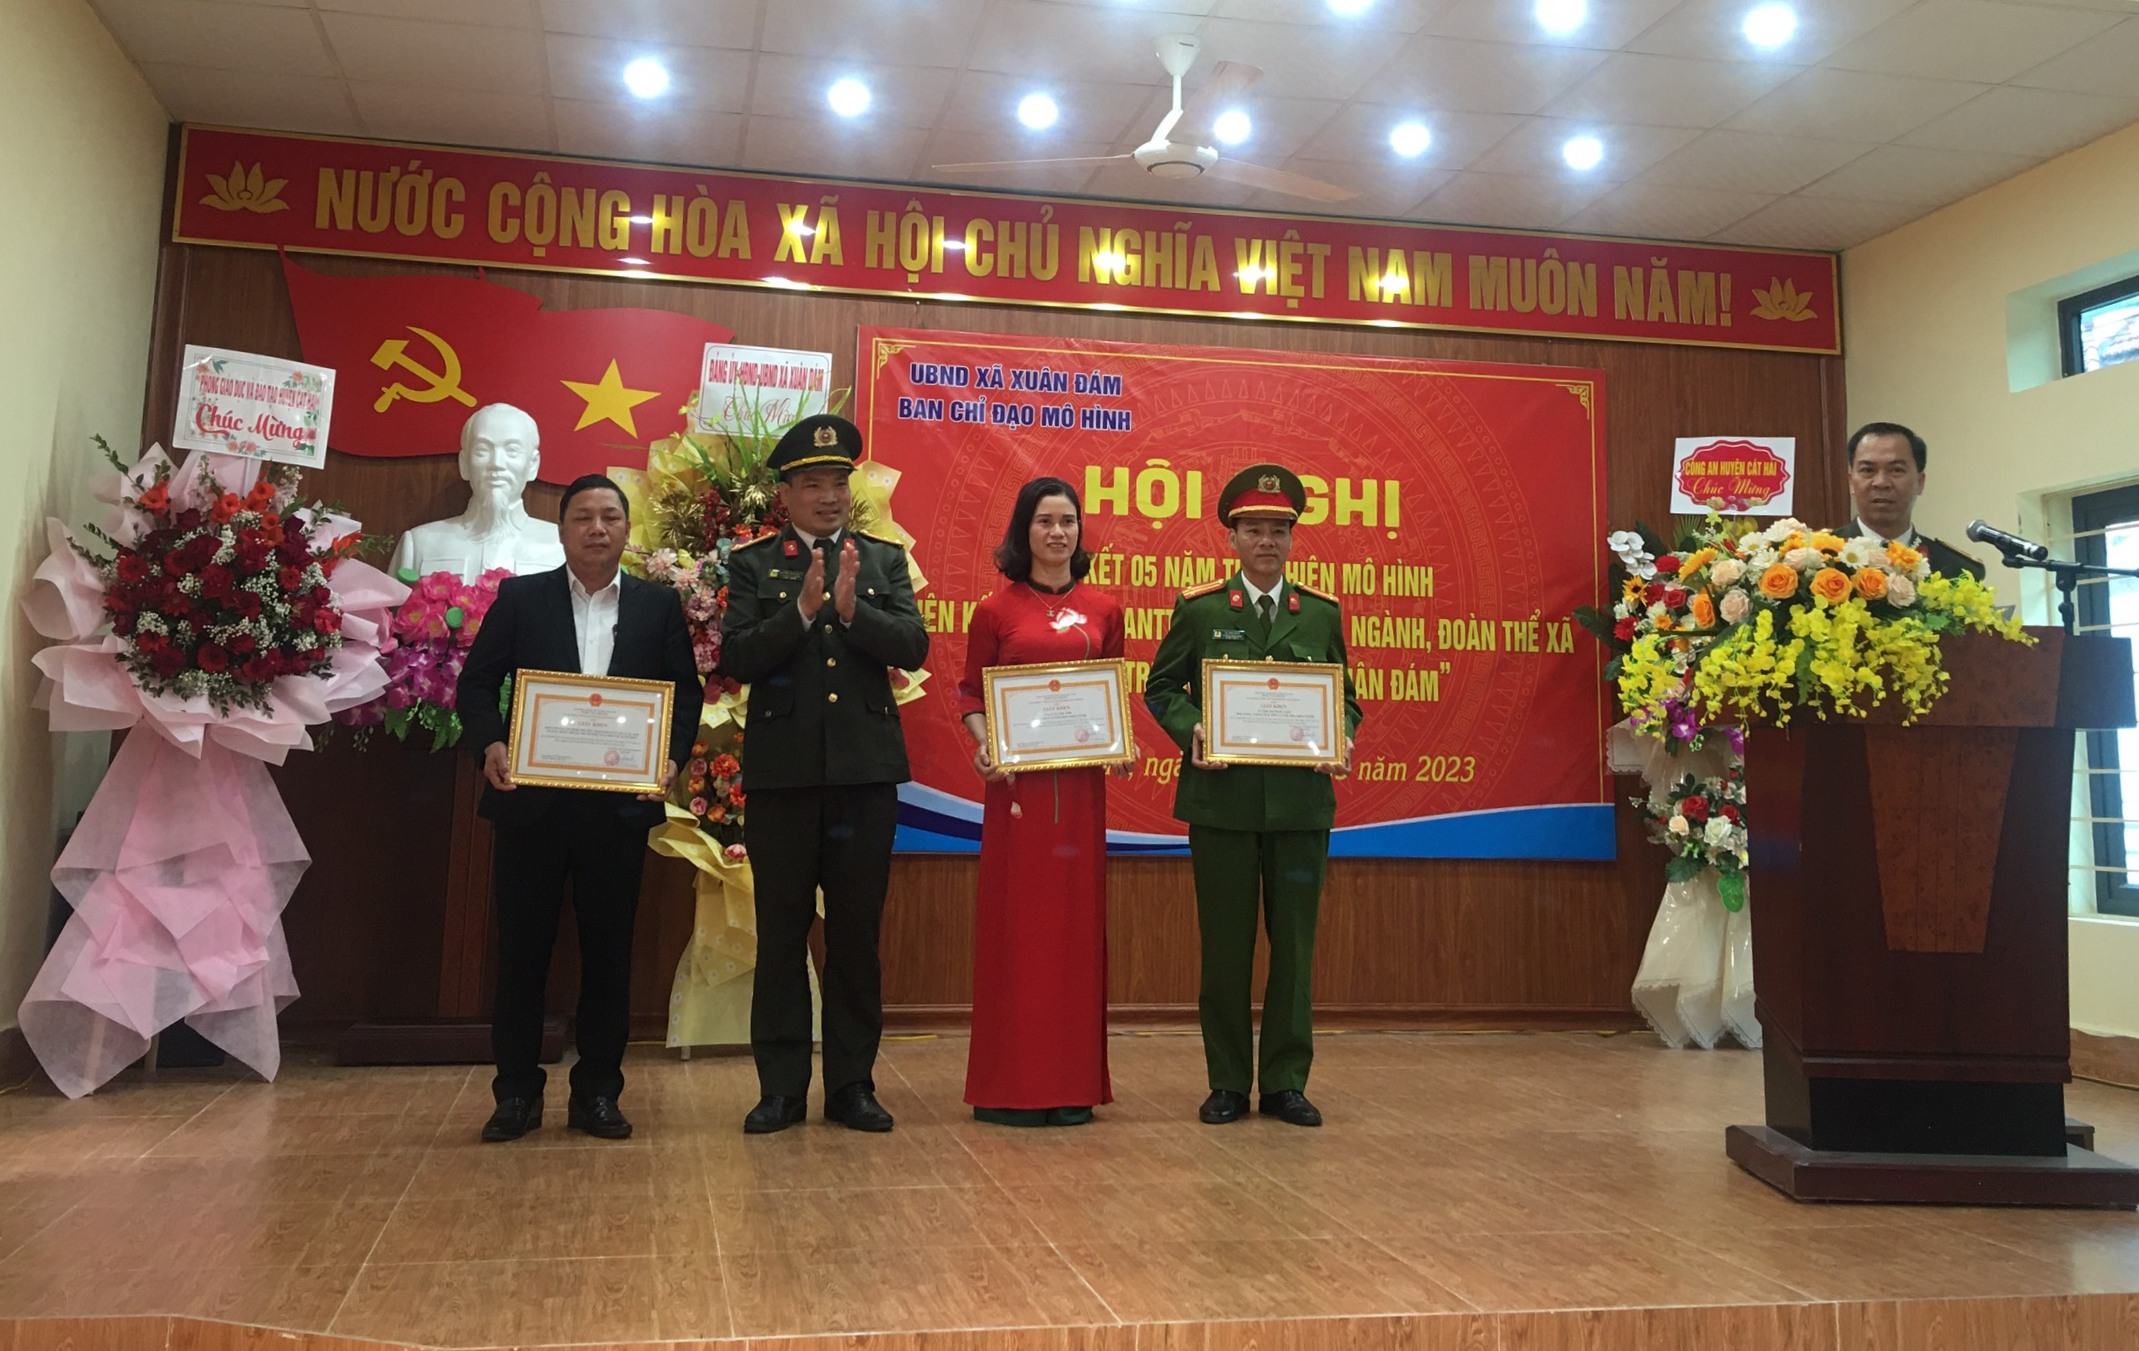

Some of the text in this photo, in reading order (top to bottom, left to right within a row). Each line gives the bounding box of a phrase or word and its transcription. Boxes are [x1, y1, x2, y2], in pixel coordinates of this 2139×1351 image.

[316, 160, 1732, 326] NƯỚC CỘNG HÒA XÃ HỘI CHỦ NGHĨA VIỆT NAM MUÔN NĂM!
[910, 363, 1122, 396] UBND XÃ XUÂN ĐÁM
[196, 404, 304, 449] Chúc Mừng
[898, 396, 1131, 431] BAN CHỈ ĐẠO MÔ HÌNH
[1690, 477, 1724, 495] Chúc
[1707, 461, 1719, 476] AN
[1085, 458, 1400, 540] HỘI GHỊ
[1131, 555, 1157, 587] 05
[1165, 550, 1216, 588] NĂM
[1342, 557, 1376, 595] MÔ
[1383, 559, 1434, 597] HÌNH
[1351, 610, 1432, 653] NGÀNH,
[1437, 613, 1496, 651] ĐOÀN
[1502, 609, 1539, 653] THỂ
[1546, 616, 1575, 653] XÃ
[1358, 756, 1407, 781] năm
[1415, 755, 1475, 782] 2023
